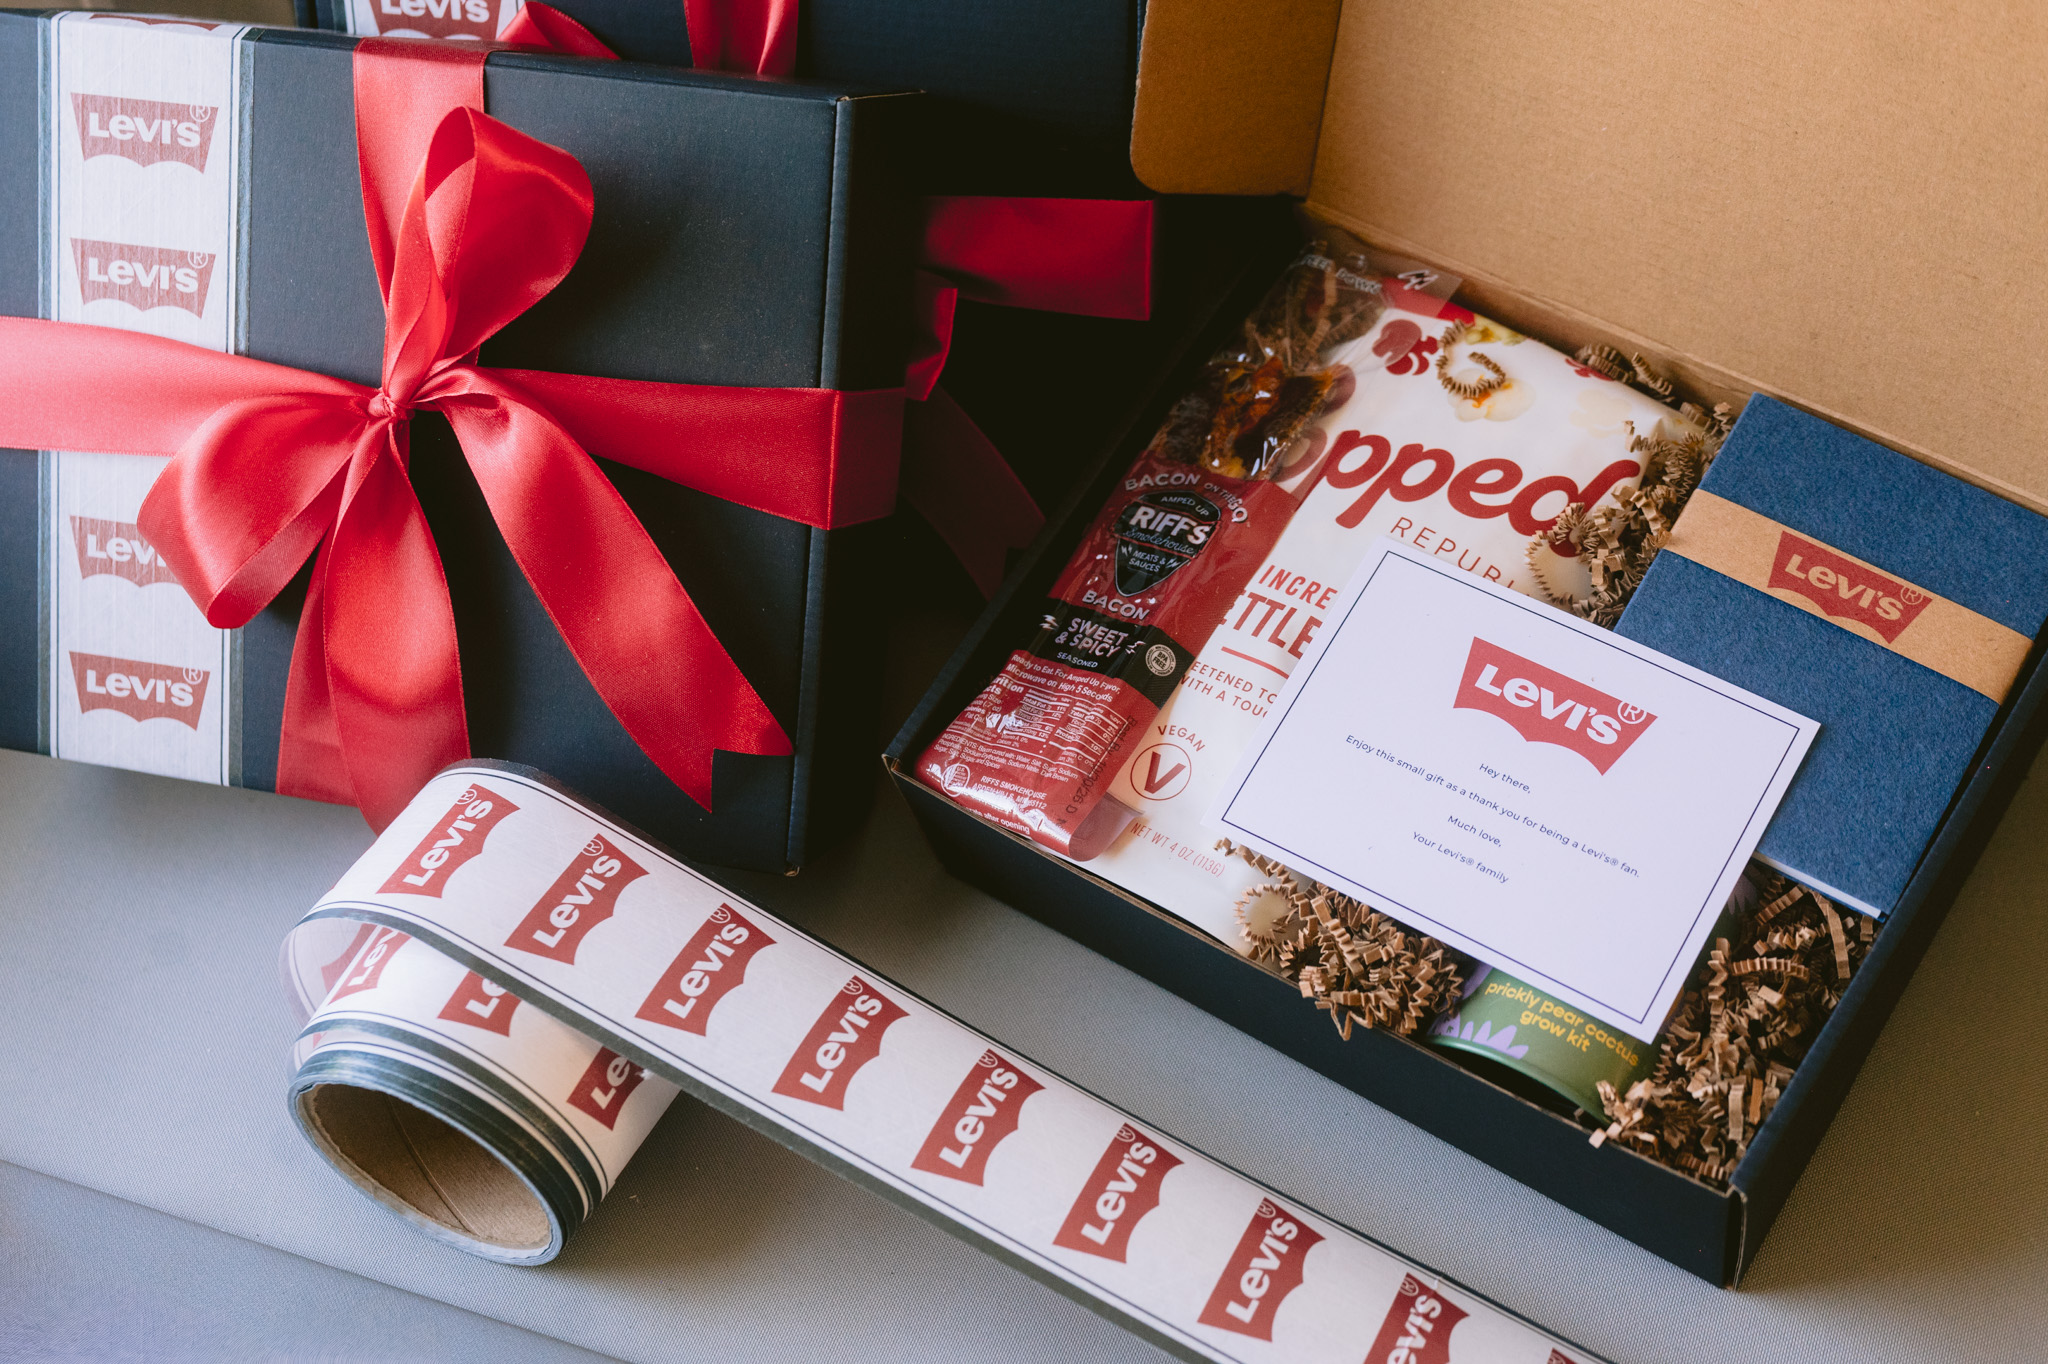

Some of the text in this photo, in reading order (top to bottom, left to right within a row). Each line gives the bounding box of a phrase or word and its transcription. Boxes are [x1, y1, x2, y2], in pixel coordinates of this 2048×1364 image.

[1125, 473, 1200, 491] BACON
[1204, 482, 1219, 492] ON
[1161, 496, 1209, 516] AMPED UP
[1129, 506, 1212, 545] RIFFS
[1128, 558, 1160, 572] SAUCES
[1133, 550, 1160, 563] MEATS
[1258, 564, 1338, 610] INCRE
[1082, 589, 1150, 620] BACON
[1055, 631, 1120, 657] & SPICY
[1068, 617, 1128, 646] SWEET
[1011, 654, 1034, 669] Ready
[1033, 663, 1041, 671] to
[1054, 668, 1067, 679] For
[1066, 673, 1089, 683] Amped
[1089, 677, 1100, 687] Up
[1056, 651, 1098, 668] SEASONED
[1006, 663, 1047, 684] Microwave
[1046, 679, 1057, 687] on
[1058, 682, 1075, 692] High
[1076, 684, 1081, 693] 5
[1190, 661, 1253, 693] EETENED
[1215, 690, 1225, 701] A
[1232, 695, 1268, 718] TOU
[1157, 725, 1205, 752] VEGAN
[980, 775, 1001, 787] RIFFS
[1000, 781, 1048, 800] SMOKEHOUSE
[1058, 767, 1078, 779] Sodium
[1479, 763, 1532, 794] Hey there,
[1345, 734, 1375, 754] Enjoy
[1375, 748, 1395, 763] this
[1396, 759, 1426, 776] small
[1425, 772, 1445, 786] gift
[1445, 782, 1458, 792] as
[1459, 788, 1467, 796] a
[1468, 791, 1499, 811] thank
[1498, 807, 1521, 821] you
[1522, 816, 1538, 829] for
[1539, 824, 1570, 845] being
[1571, 841, 1579, 849] a
[1620, 862, 1640, 878] fan.
[1000, 818, 1030, 835] opening
[1130, 822, 1152, 837] NET
[1152, 831, 1170, 848] WT
[1169, 842, 1178, 854] 4
[1177, 846, 1194, 860] OZ
[1447, 815, 1502, 847] Much love,
[1412, 831, 1436, 848] Your
[1475, 862, 1509, 883] family
[1484, 981, 1639, 1067] prickly pear cactus
[1520, 1010, 1591, 1053] grow kit
